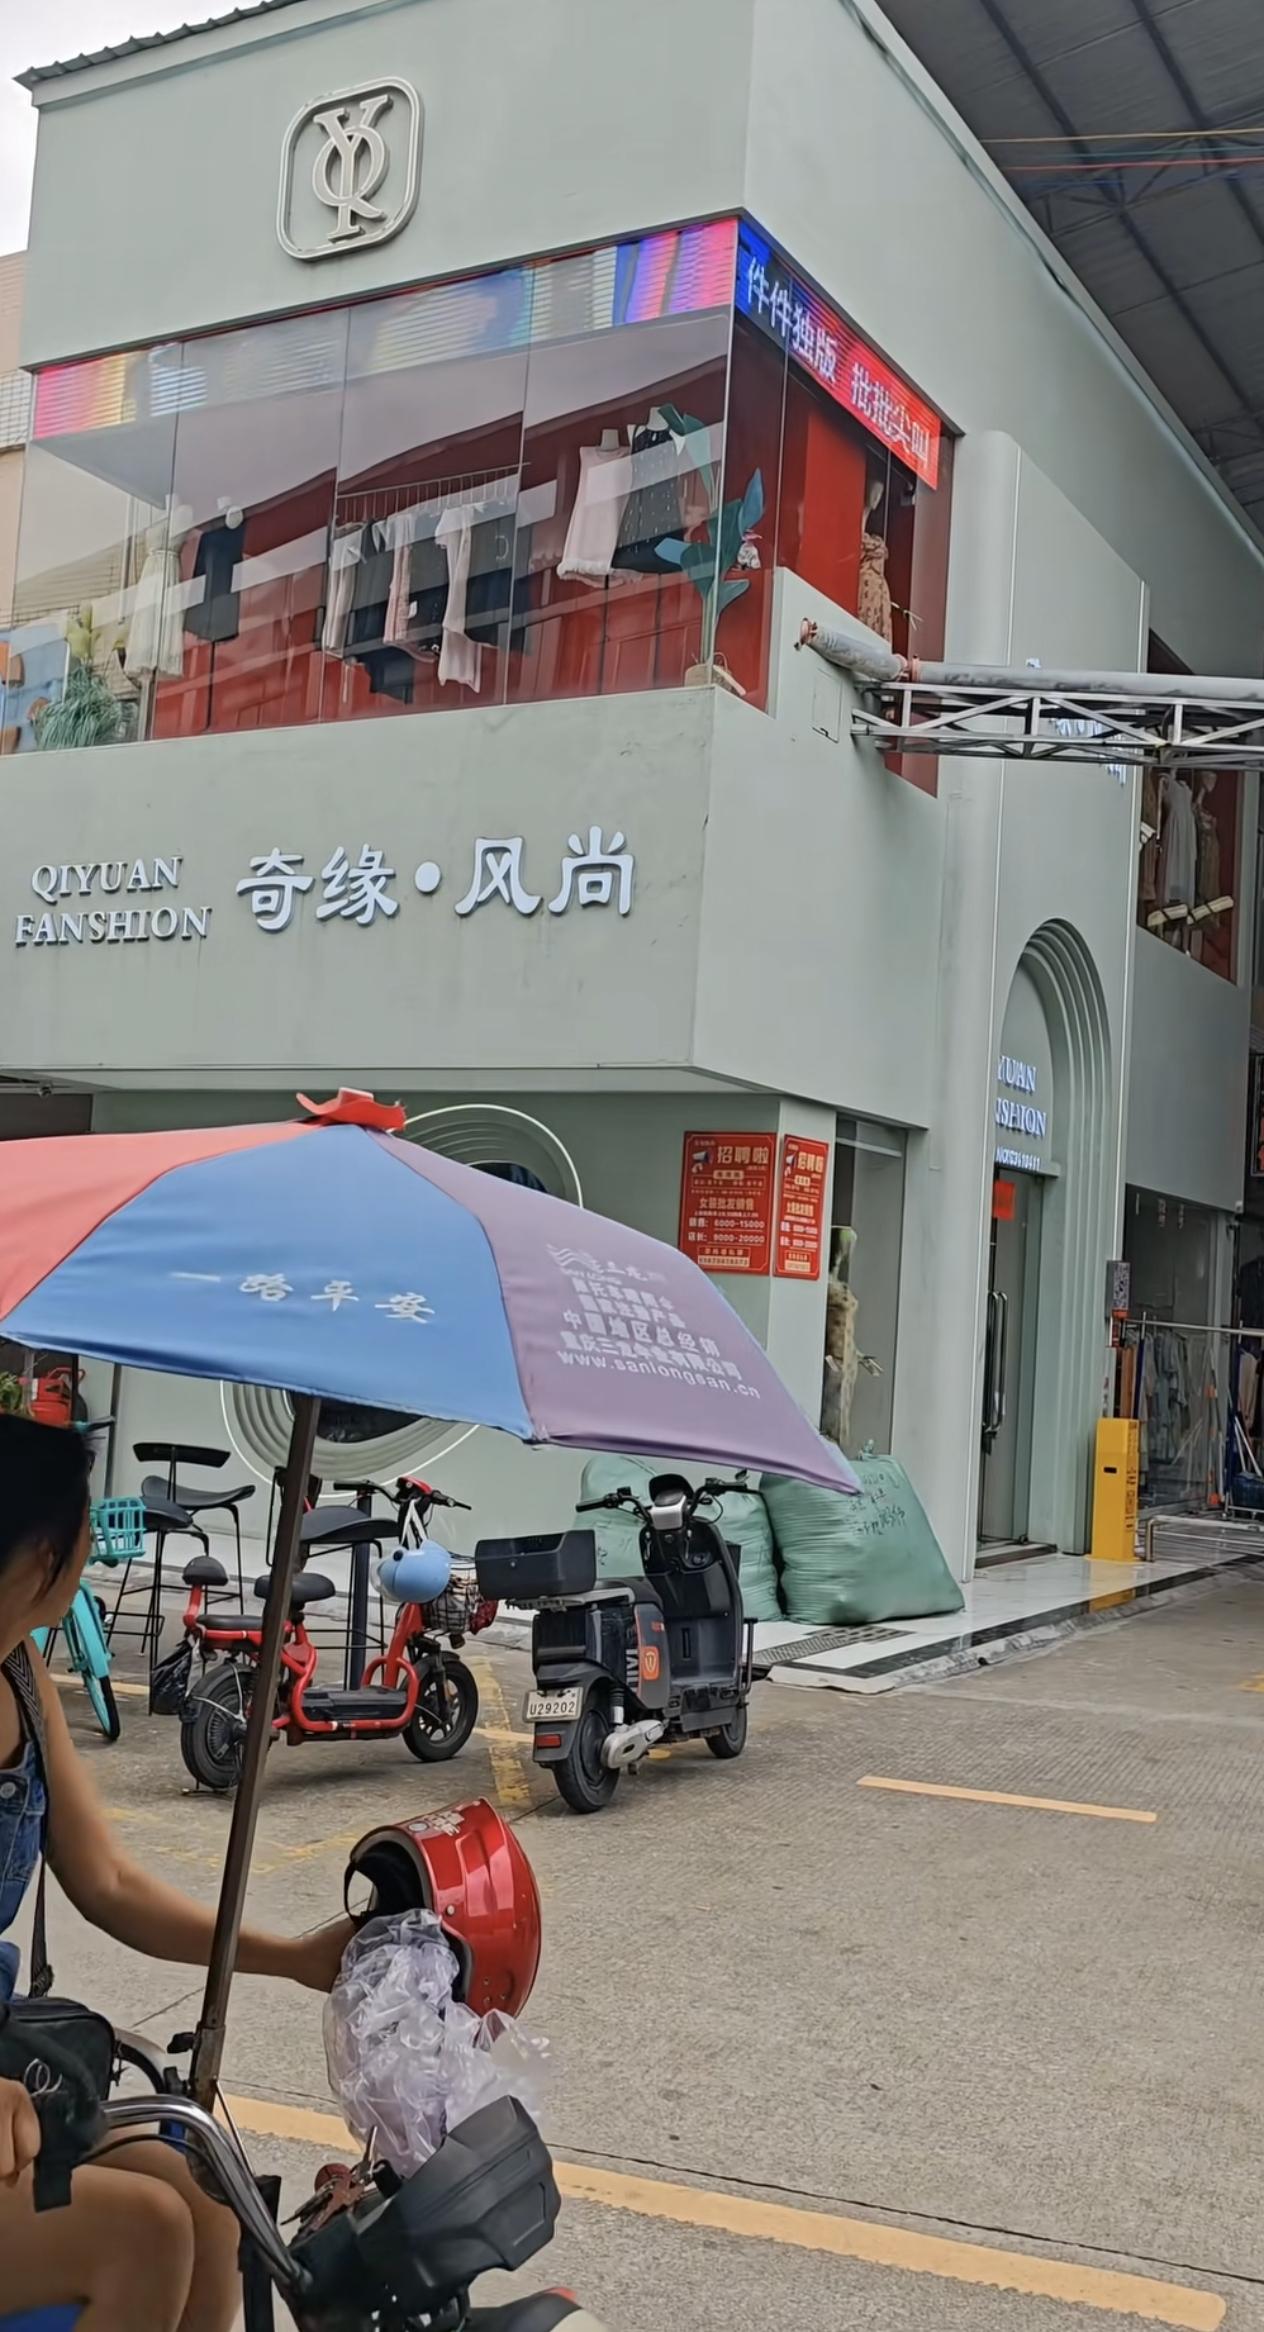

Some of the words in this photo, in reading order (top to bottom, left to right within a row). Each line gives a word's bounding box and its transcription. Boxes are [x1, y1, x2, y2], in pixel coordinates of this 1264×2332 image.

[747, 256, 839, 385] 件件独版
[851, 362, 930, 469] 批批尖叫
[32, 856, 182, 905] QIYUAN
[15, 906, 212, 946] FANSHION
[562, 1308, 721, 1358] 中国地区总经销
[557, 1350, 762, 1400] www.sanlongsan.cn
[530, 1701, 575, 1715] U29202
